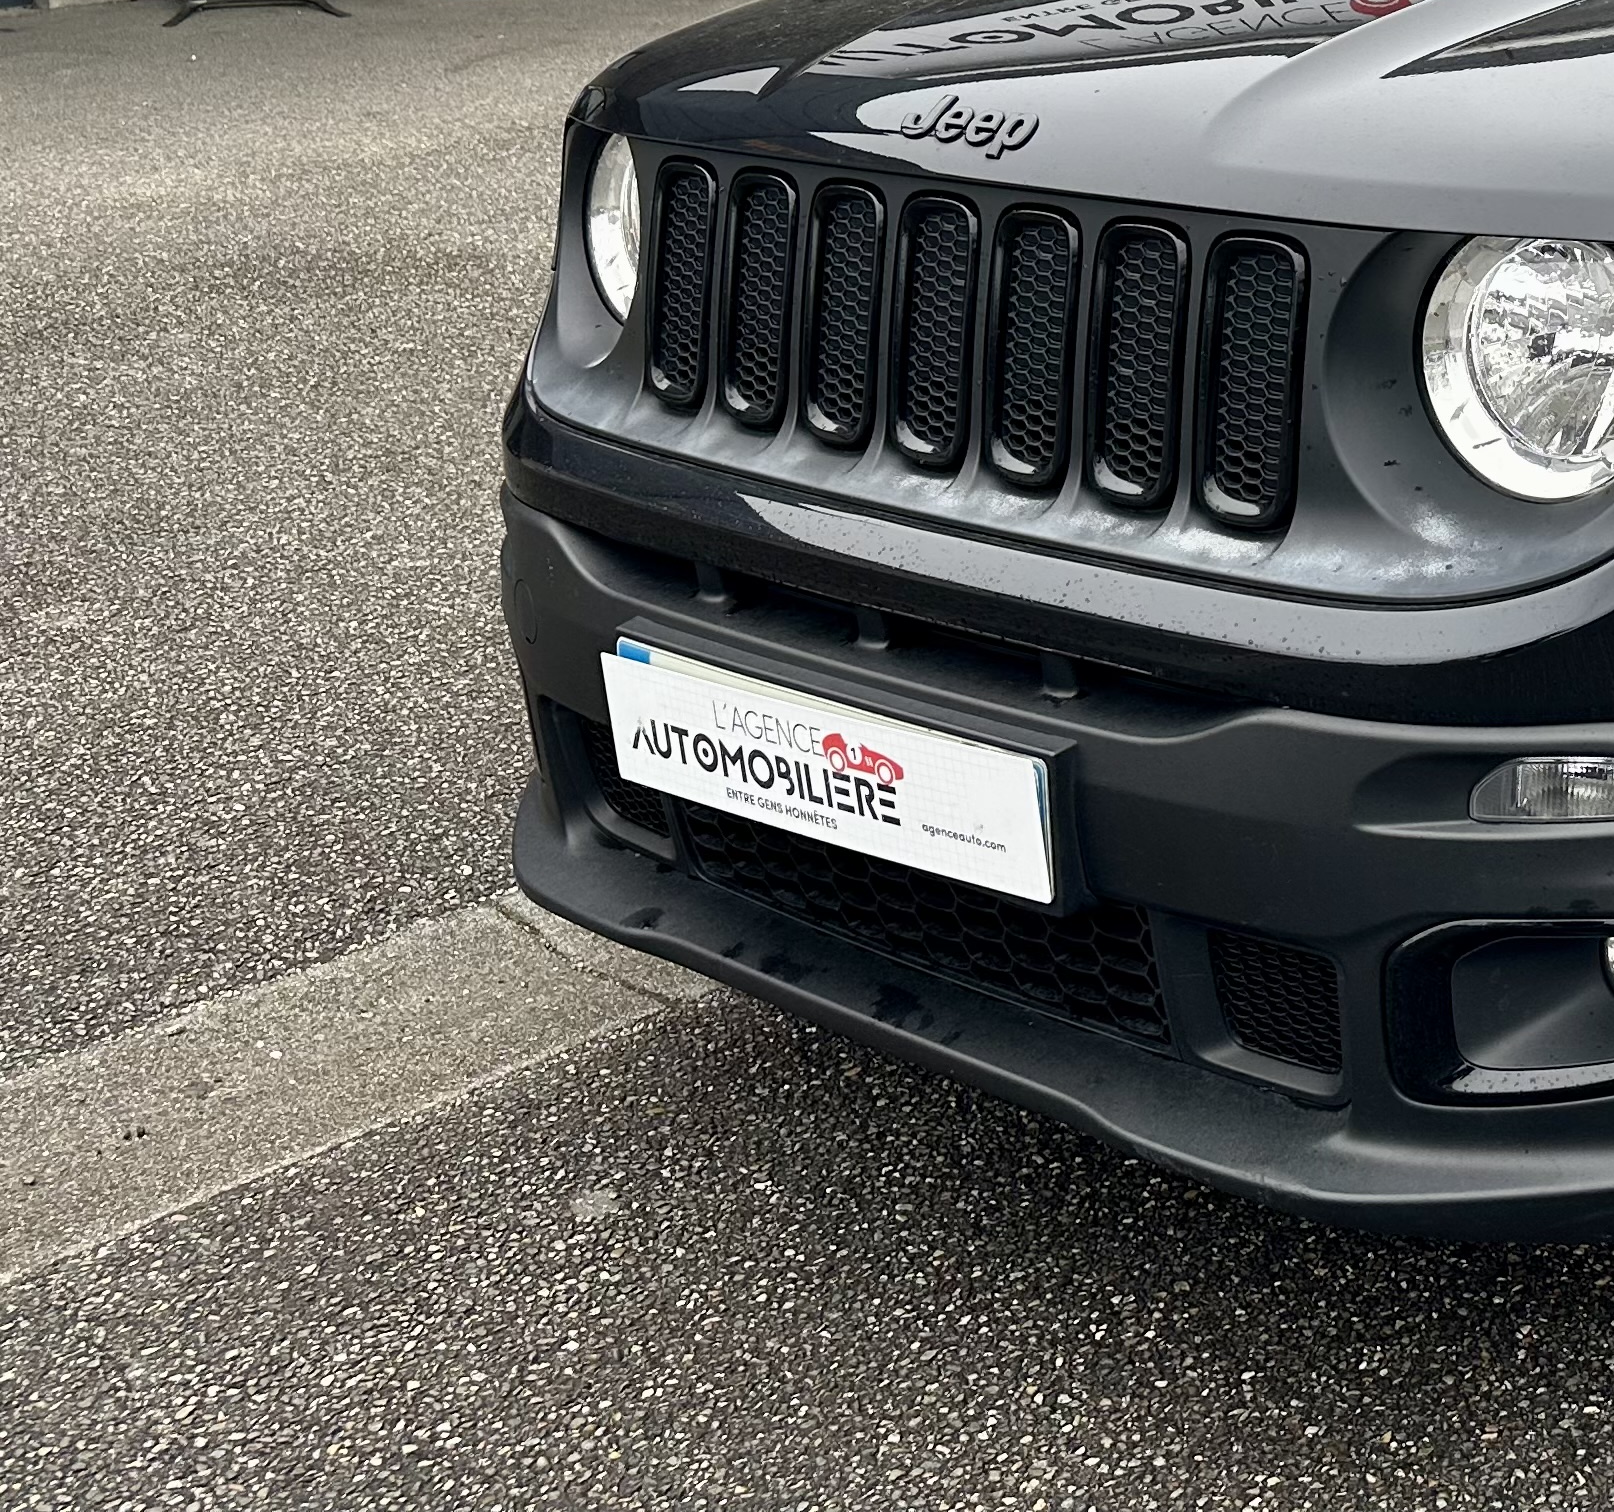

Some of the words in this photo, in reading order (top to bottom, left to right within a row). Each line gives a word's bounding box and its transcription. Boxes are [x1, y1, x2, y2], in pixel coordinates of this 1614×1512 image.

[900, 94, 1040, 159] Jeep
[726, 787, 756, 806] ENTRE
[757, 795, 784, 814] GENS
[785, 804, 838, 830] HONNÊTES
[921, 822, 1007, 854] agenceauto.com
